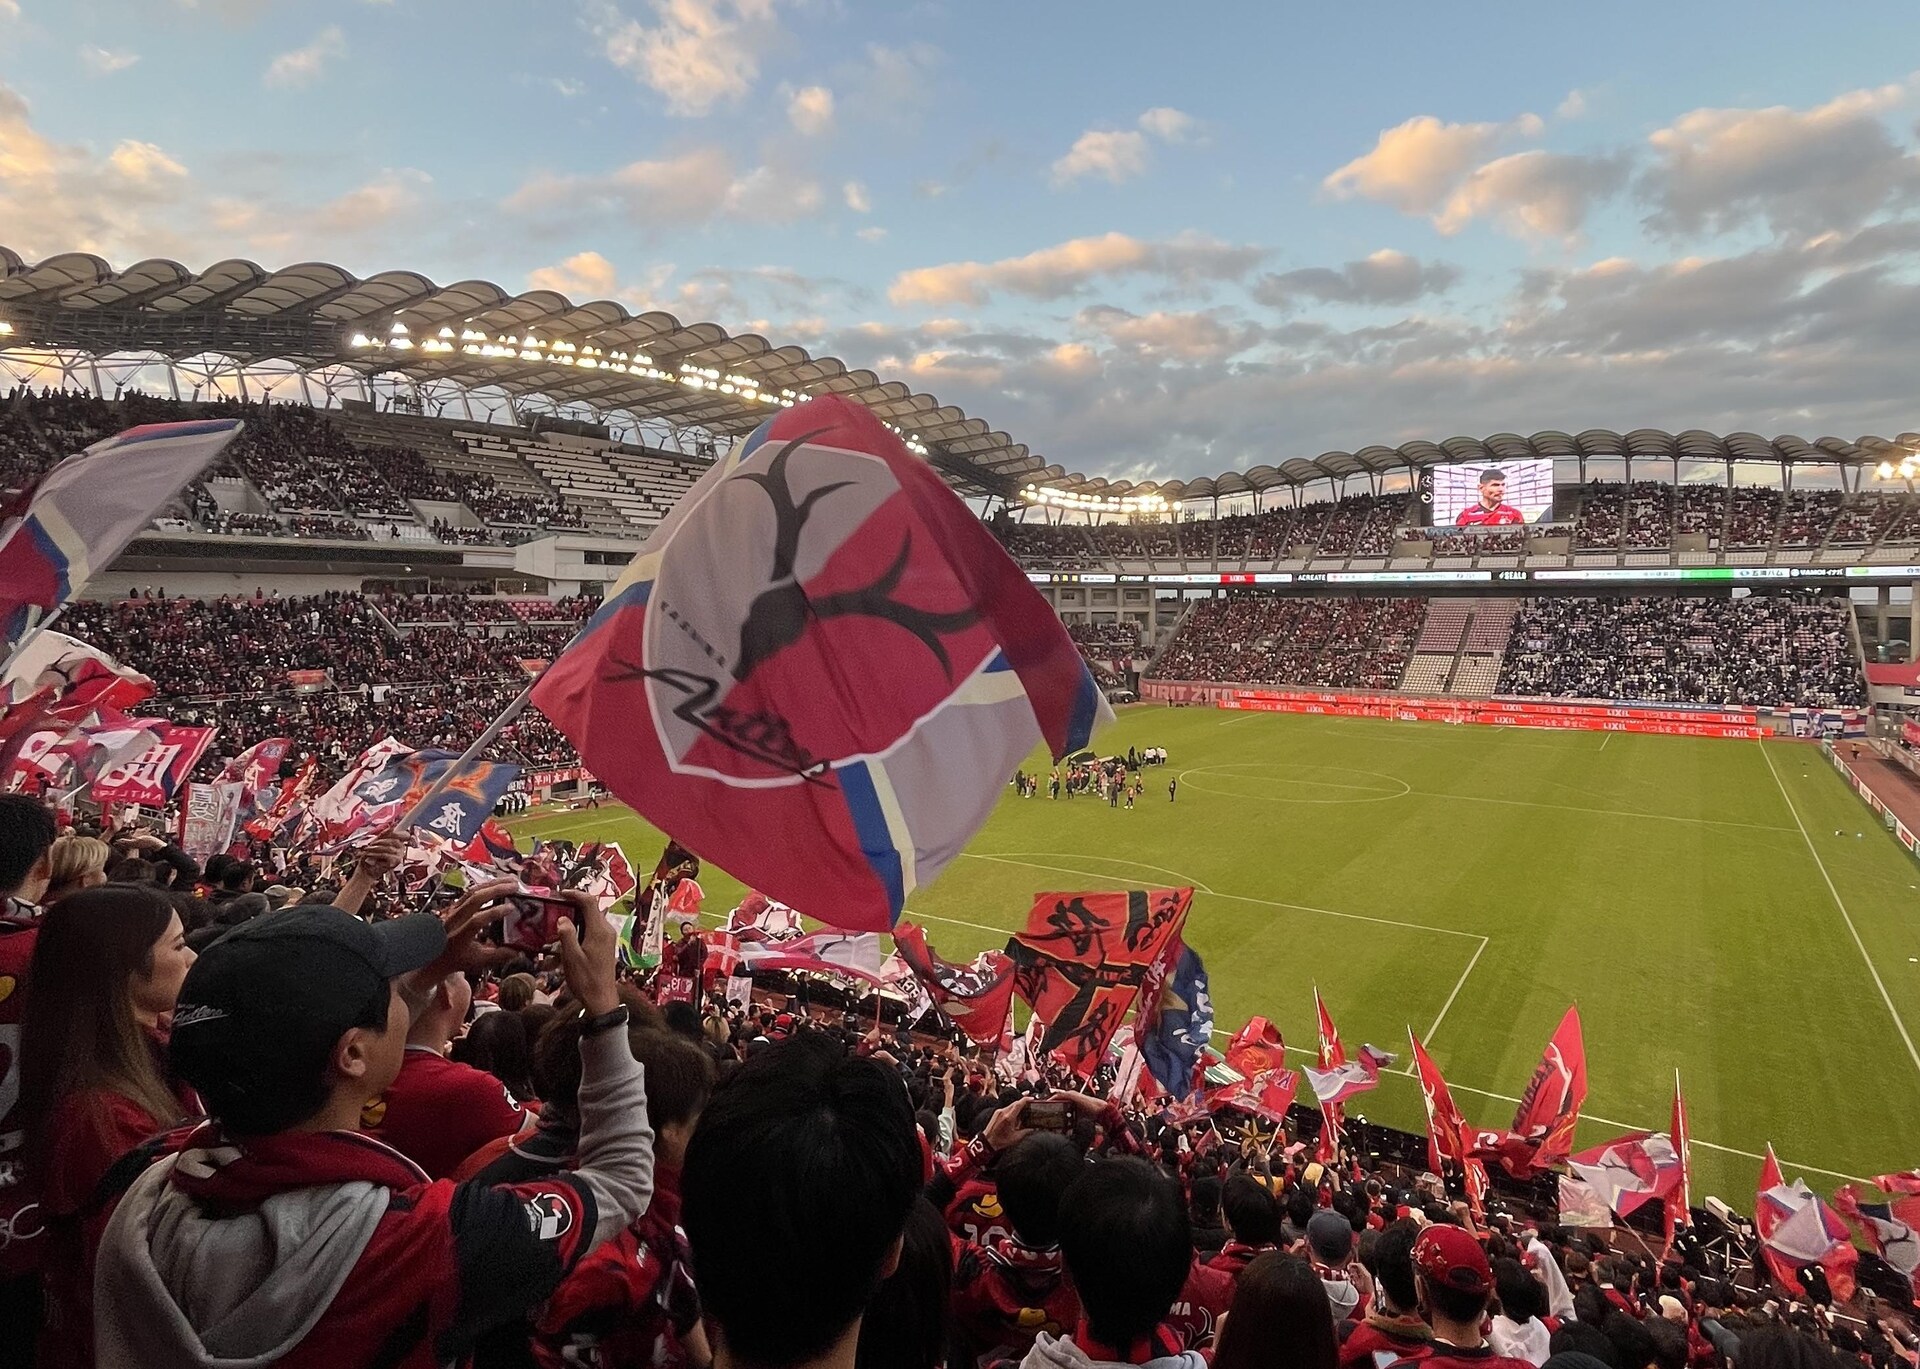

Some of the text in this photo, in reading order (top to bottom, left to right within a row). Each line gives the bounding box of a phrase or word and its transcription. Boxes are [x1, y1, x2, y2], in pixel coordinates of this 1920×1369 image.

[1306, 705, 1325, 713] LIXIL
[1606, 709, 1631, 717] LIXIL
[1494, 716, 1517, 724] LIXIL
[1721, 714, 1747, 724] LIXIL
[1603, 722, 1627, 730] LIXIL
[1722, 728, 1750, 737] LIXIL
[967, 1134, 985, 1158] 12
